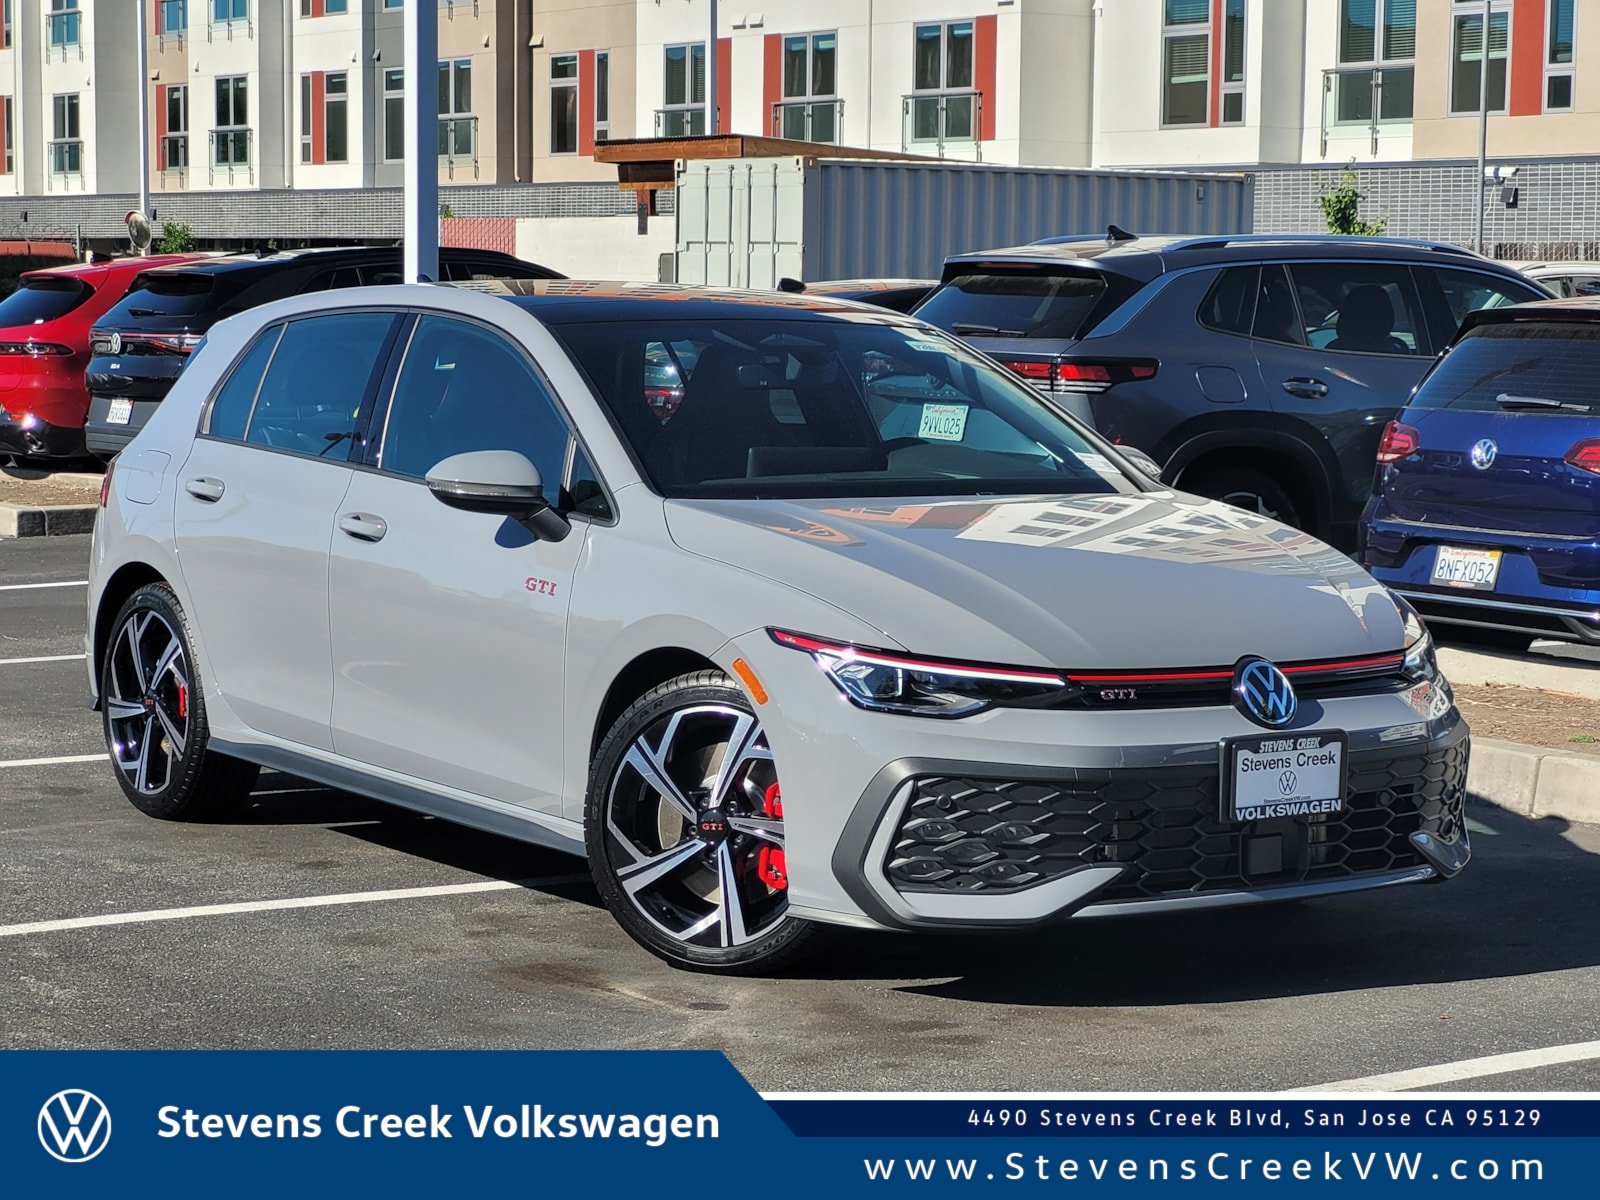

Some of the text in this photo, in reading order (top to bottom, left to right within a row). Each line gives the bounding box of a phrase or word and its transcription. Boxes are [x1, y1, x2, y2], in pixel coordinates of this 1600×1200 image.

[921, 415, 961, 435] 9VVL025
[1437, 558, 1494, 583] 8NFX052
[524, 576, 557, 597] GTI
[1100, 688, 1137, 700] GTI
[1241, 660, 1297, 724] VW
[1259, 736, 1321, 753] STEVENS CREEK
[1241, 751, 1337, 773] Stevens Creek
[1235, 799, 1342, 821] VOLKSWAGEN
[701, 822, 723, 831] GTI
